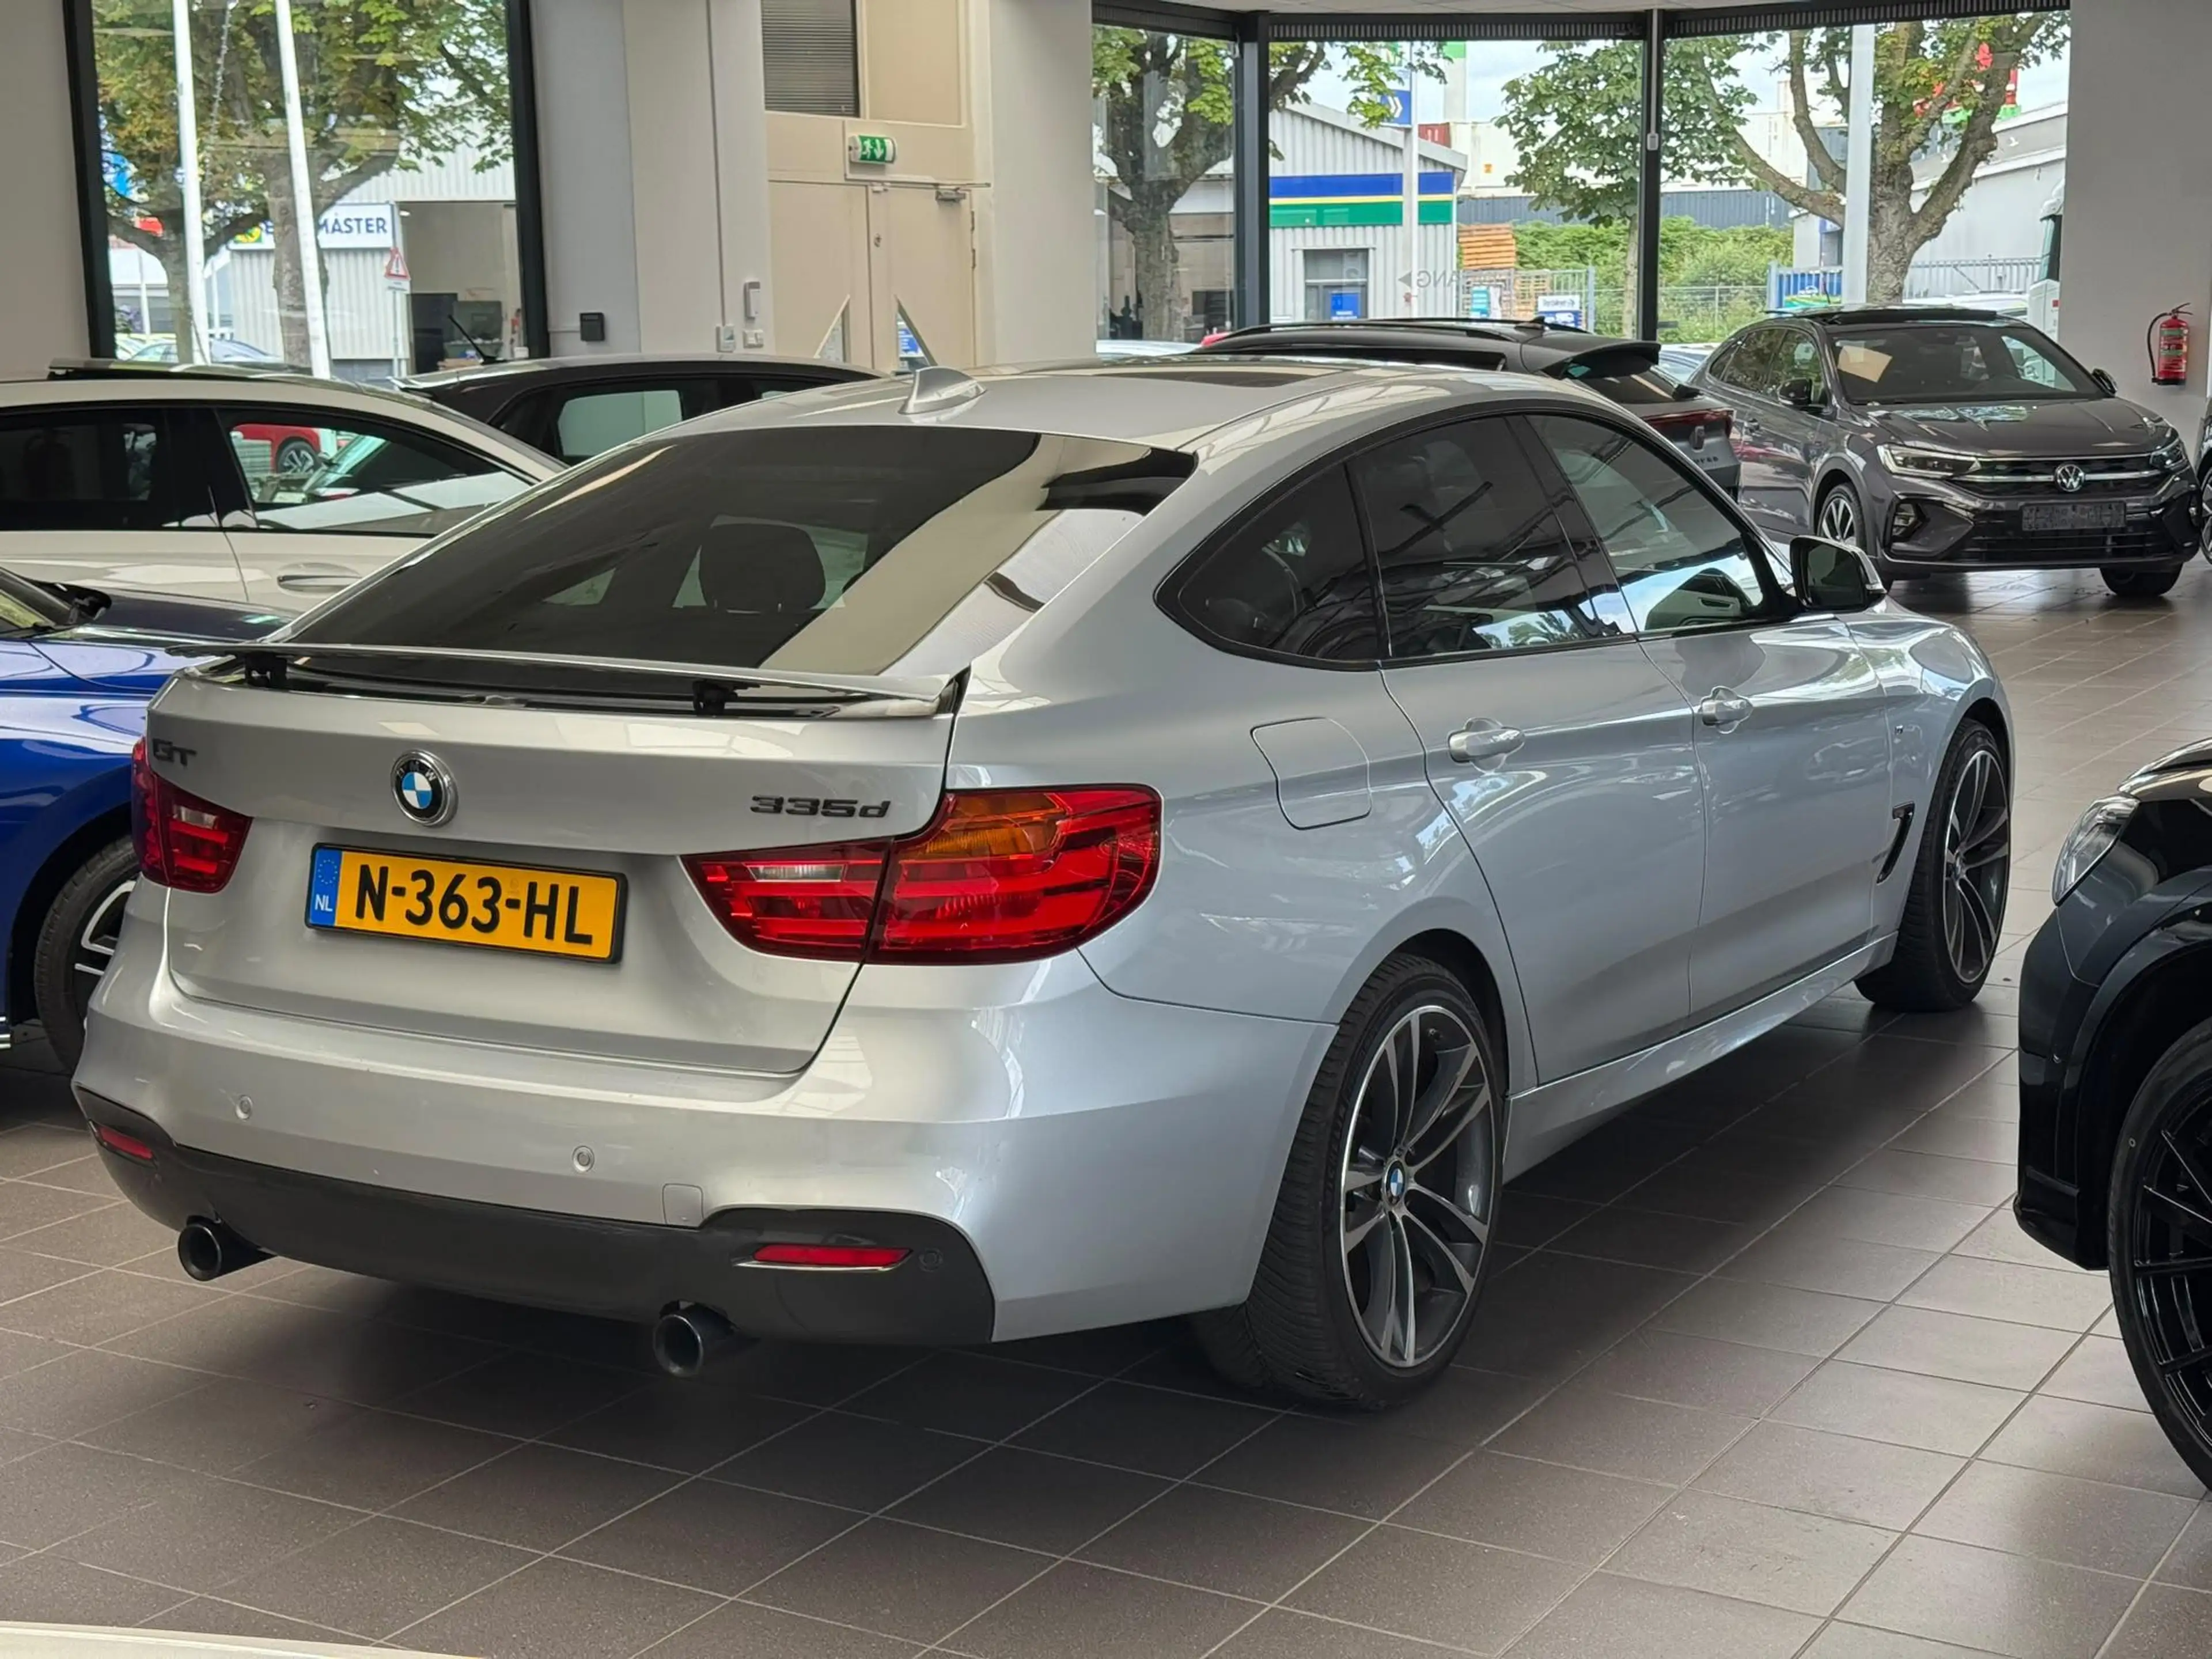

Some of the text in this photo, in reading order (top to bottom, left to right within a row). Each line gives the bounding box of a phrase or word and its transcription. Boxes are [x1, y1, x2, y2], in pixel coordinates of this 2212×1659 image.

[153, 738, 198, 767] GT
[750, 796, 891, 817] 335d
[315, 894, 333, 912] NL
[355, 864, 592, 945] N-363-HL
